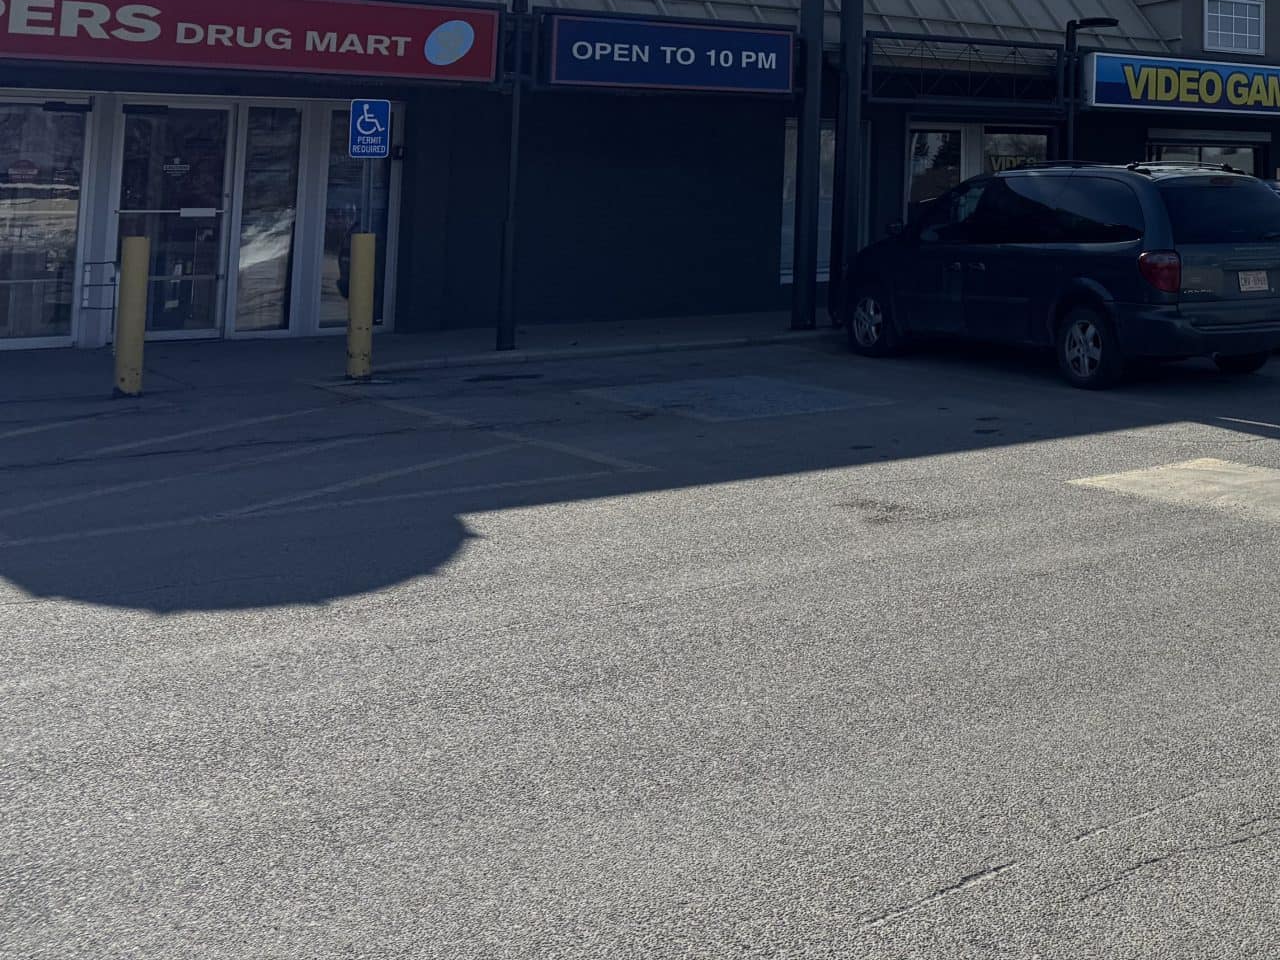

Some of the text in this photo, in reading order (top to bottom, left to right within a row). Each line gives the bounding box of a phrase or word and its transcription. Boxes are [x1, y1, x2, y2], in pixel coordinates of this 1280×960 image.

[175, 22, 293, 51] DRUG
[304, 30, 412, 58] MART
[572, 41, 777, 70] OPEN TO 10 PM
[1124, 65, 1222, 103] VIDEO
[352, 145, 386, 153] REQUIRED
[357, 136, 382, 144] PERMIT
